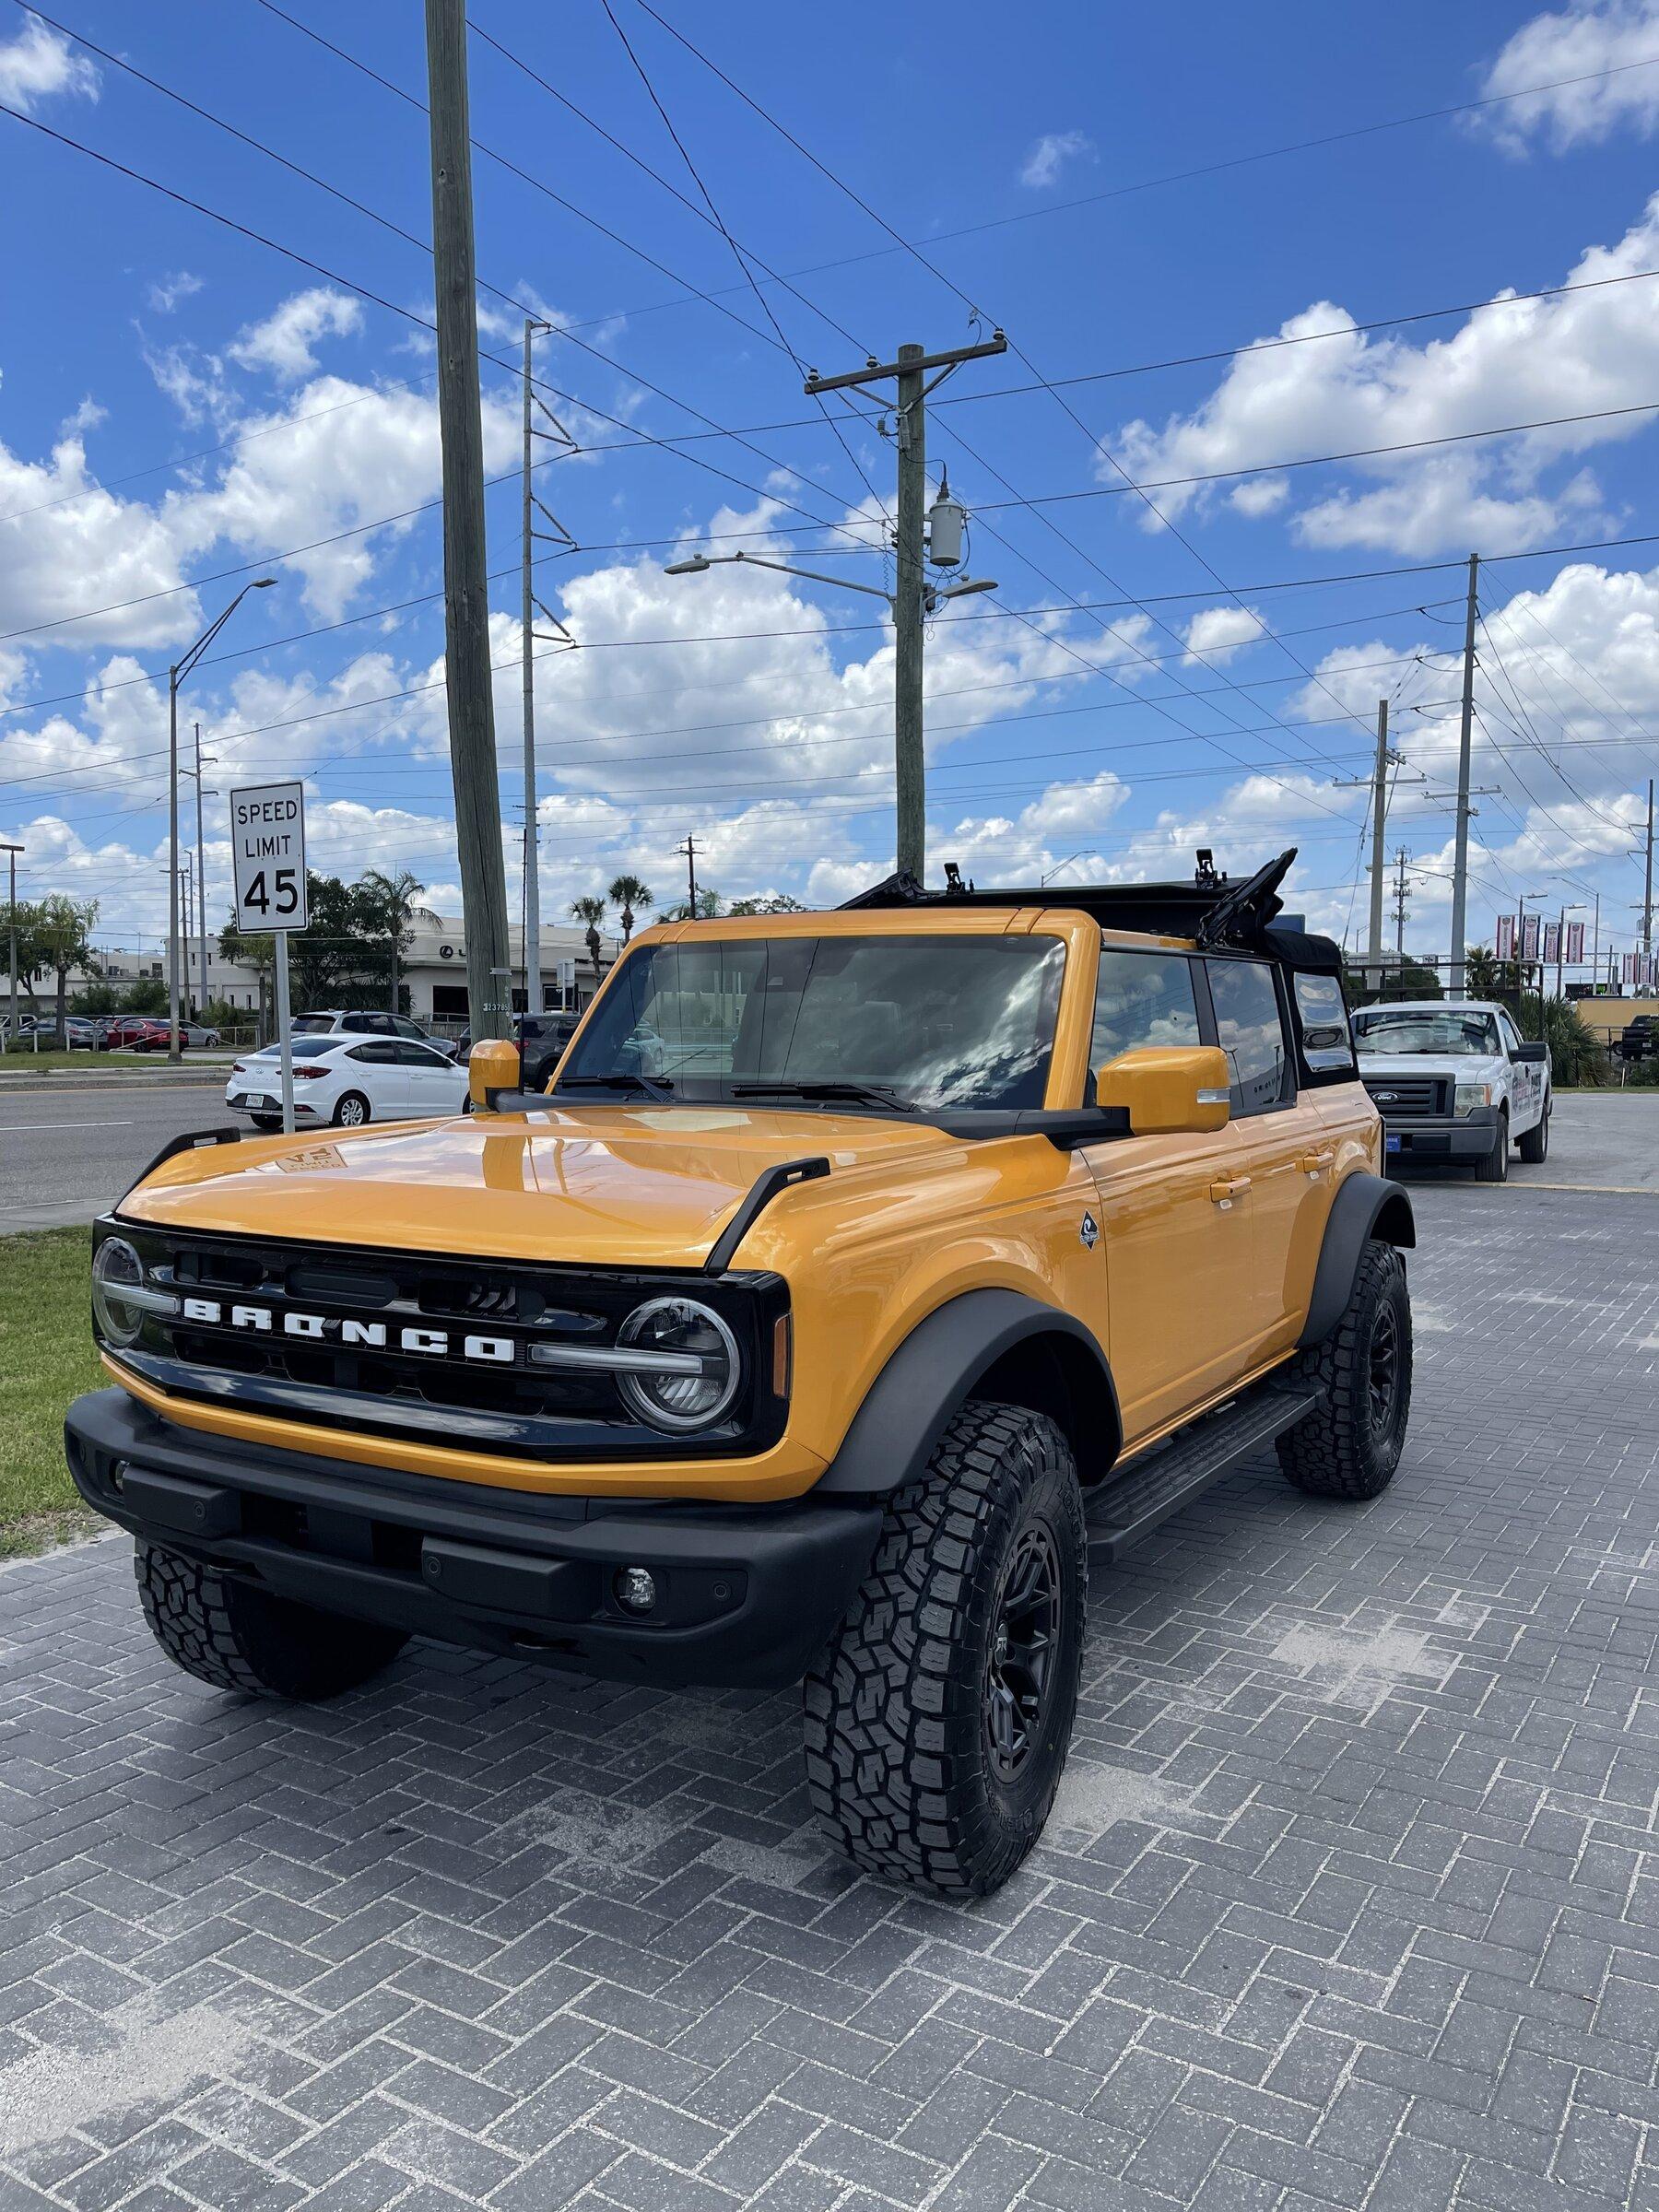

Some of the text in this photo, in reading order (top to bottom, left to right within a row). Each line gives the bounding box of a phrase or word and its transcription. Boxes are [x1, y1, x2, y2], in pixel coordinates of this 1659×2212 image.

[238, 800, 297, 825] SPEED
[245, 835, 291, 858] LIMIT
[244, 868, 298, 915] 45
[184, 1298, 515, 1362] BRONCO
